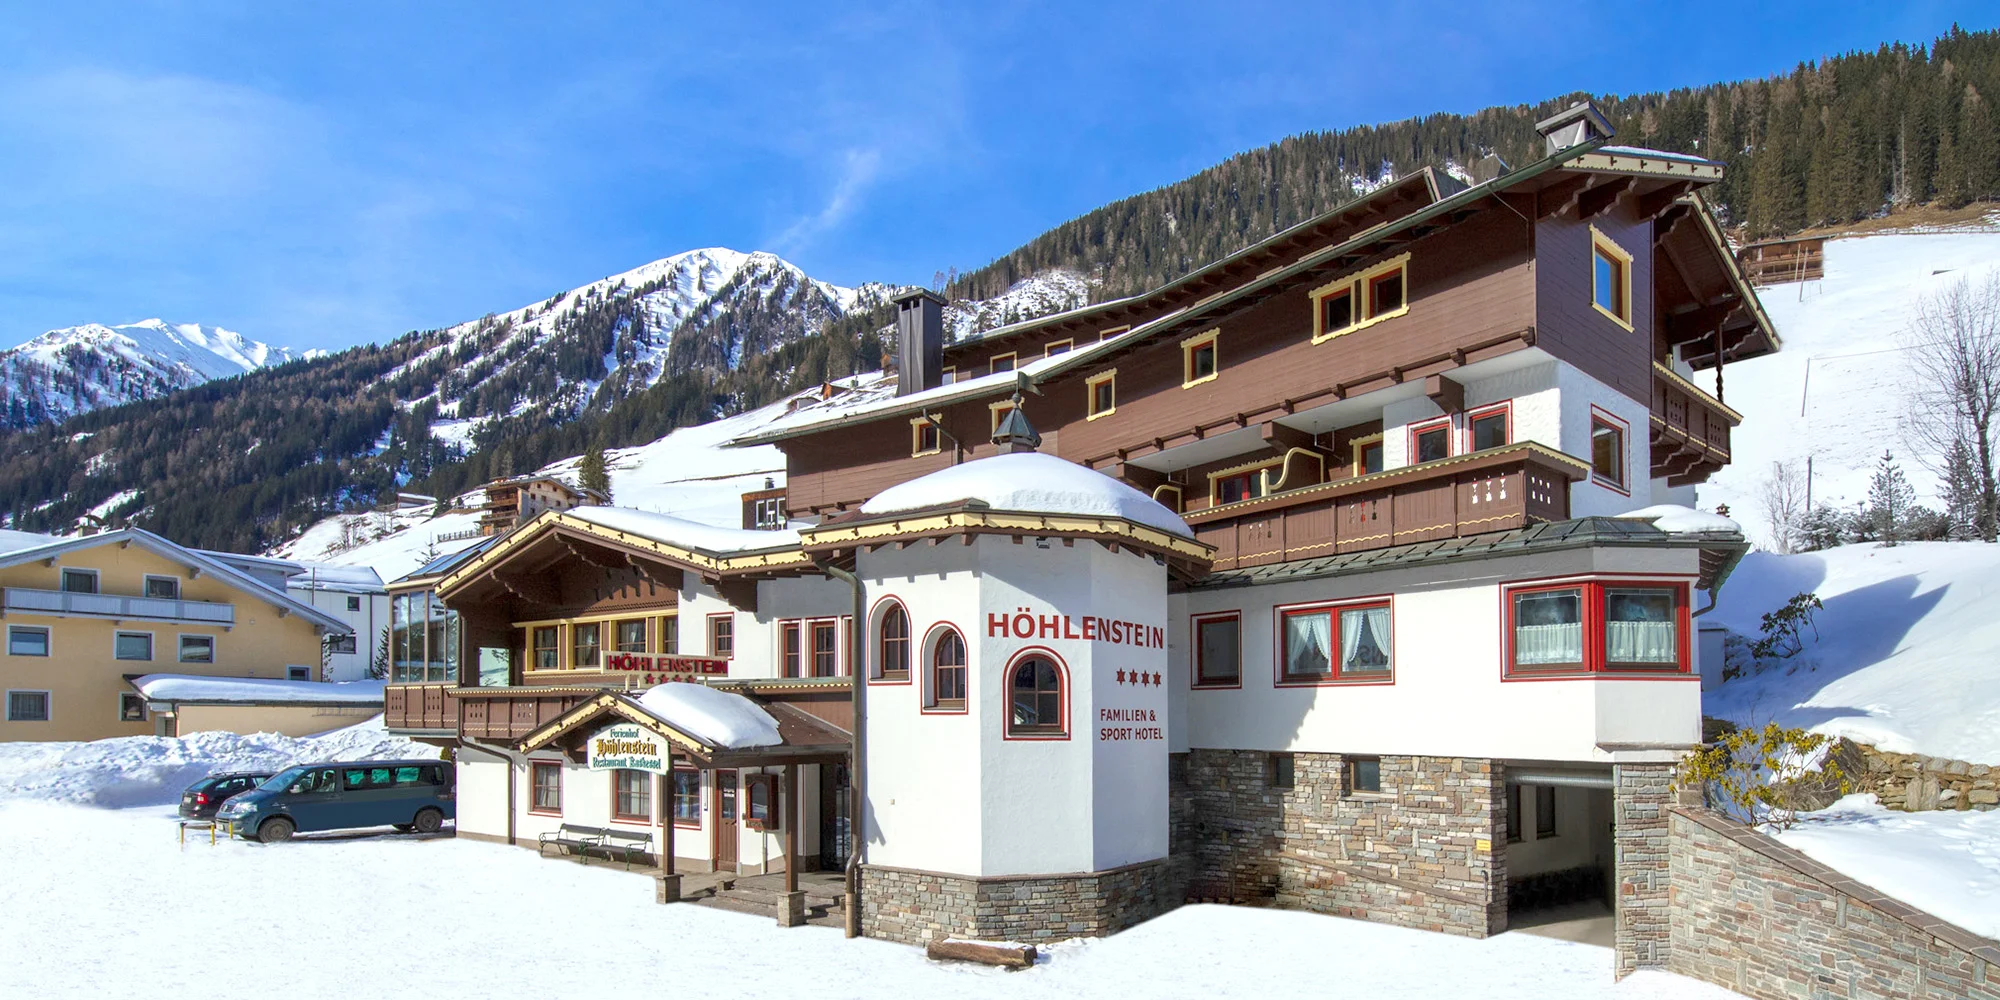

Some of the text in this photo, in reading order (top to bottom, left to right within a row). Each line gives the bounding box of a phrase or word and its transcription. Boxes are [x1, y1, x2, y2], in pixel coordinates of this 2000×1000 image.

[988, 607, 1164, 649] HÖHLENSTEIN
[606, 652, 729, 674] HÖHLENSTEIN
[1100, 708, 1156, 721] FAMILIEN &
[610, 728, 640, 738] Ferienhof
[1100, 727, 1163, 741] SPORT HOTEL
[596, 737, 657, 757] Höhlenstein
[592, 757, 628, 768] Restaurant
